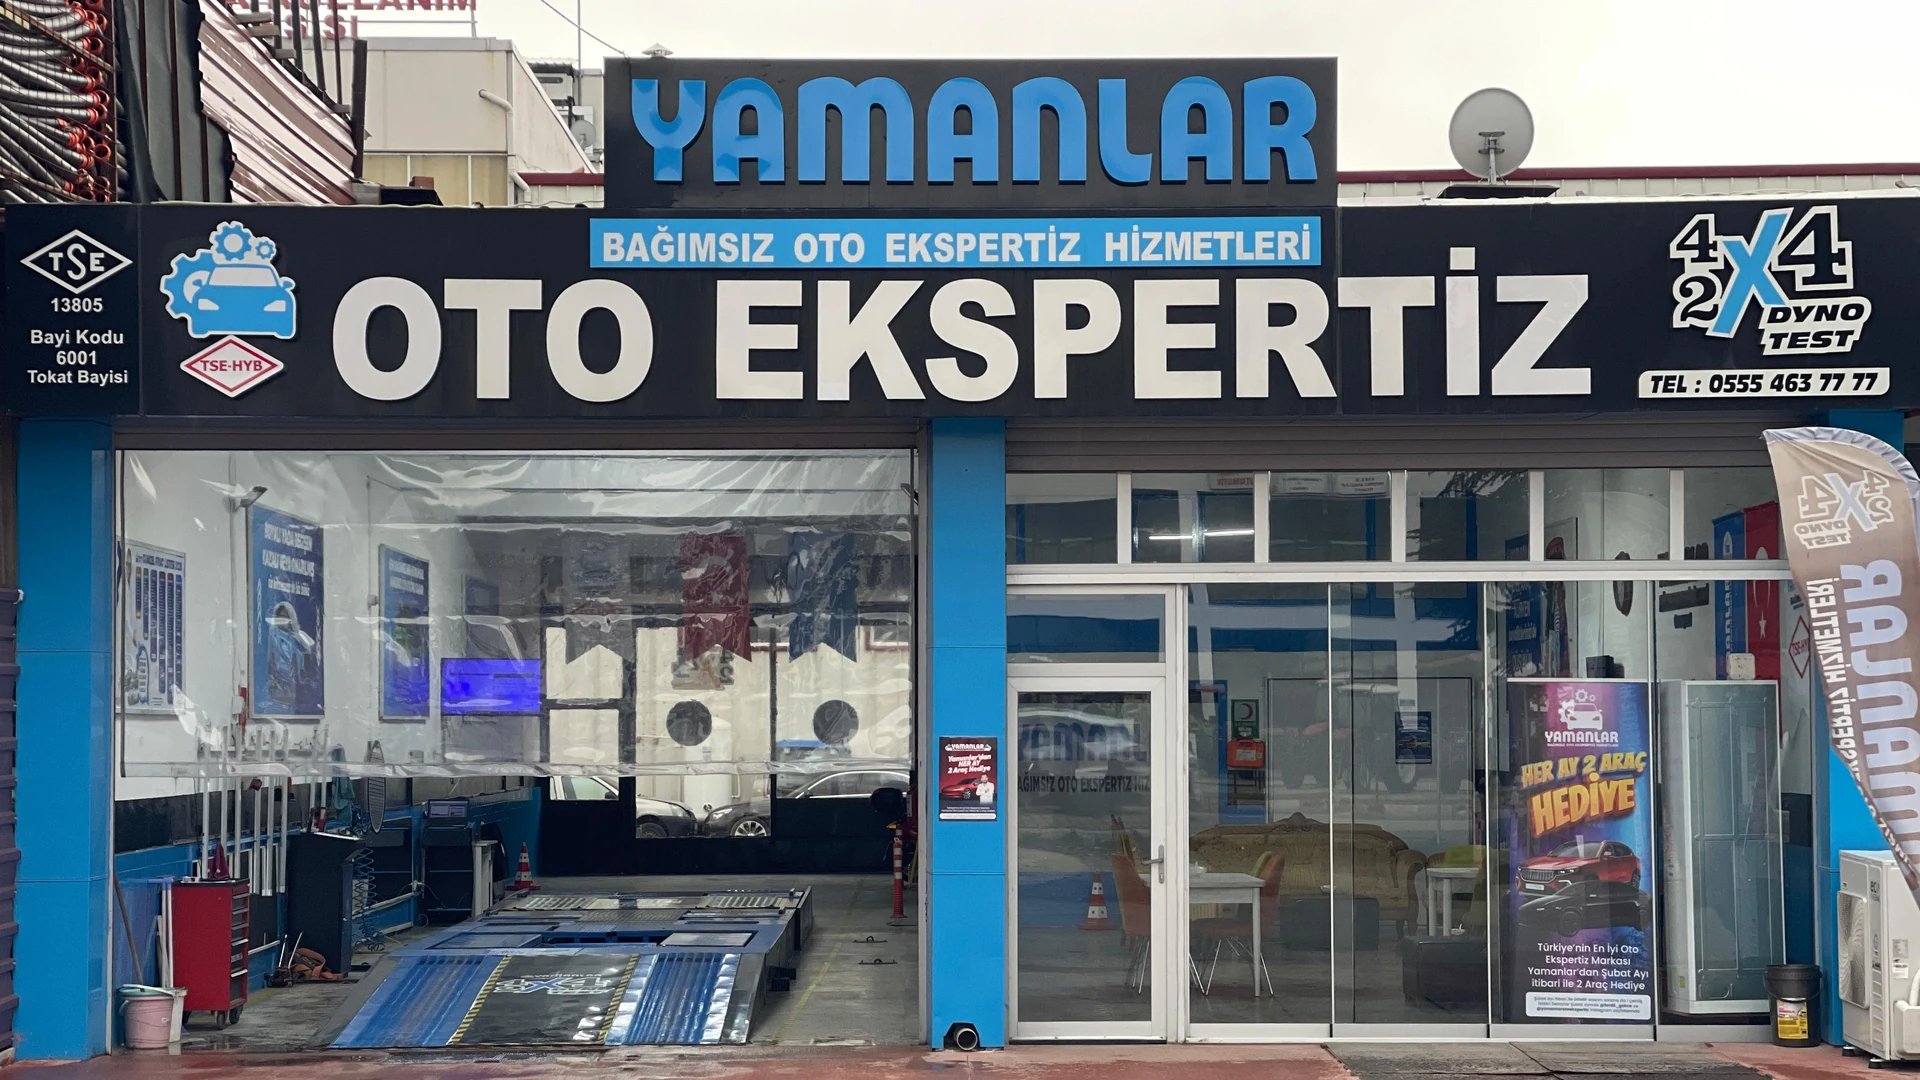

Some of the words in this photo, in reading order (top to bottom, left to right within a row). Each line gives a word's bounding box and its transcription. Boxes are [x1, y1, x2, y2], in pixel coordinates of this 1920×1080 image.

[631, 75, 1318, 185] YAMANLAR
[602, 225, 775, 264] BAĞIMSIZ
[793, 232, 865, 264] OTO
[885, 225, 1081, 264] EKSPERTİZ
[1105, 223, 1312, 263] HİZMETLERİ
[49, 243, 105, 280] TSE
[51, 298, 103, 312] 13805
[1766, 303, 1865, 324] DYNO
[333, 276, 654, 402] OTO
[716, 245, 1592, 402] EKSPERTİZ
[31, 330, 71, 347] Bayi
[77, 330, 124, 345] Kodu
[1768, 329, 1855, 350] TEST
[56, 351, 97, 365] 6001
[200, 360, 263, 372] TSE-HYB
[27, 370, 73, 384] Tokat
[78, 370, 129, 387] Bayisi
[1650, 375, 1688, 394] TEL
[1709, 374, 1764, 393] 0555
[1770, 374, 1812, 392] 463
[1820, 373, 1845, 391] 77
[1852, 373, 1879, 391] 77
[1545, 731, 1618, 743] YAMANLAR
[952, 743, 985, 751] YAMANLAR
[948, 754, 991, 762] Yamanlar'dan
[1521, 760, 1554, 788] HER
[1558, 756, 1581, 779] AY
[1582, 755, 1596, 775] 2
[1599, 751, 1647, 773] ARAÇ
[1531, 773, 1636, 836] HEDİYE
[1537, 943, 1591, 954] Türkiye'nin
[1593, 944, 1605, 953] En
[1607, 943, 1618, 955] İyi
[1621, 945, 1639, 953] Oto
[1545, 955, 1589, 966] Ekspertiz
[1591, 956, 1631, 965] Markası
[1528, 967, 1599, 976] Yamanlar'dan
[1601, 968, 1631, 979] Şubat
[1633, 969, 1649, 979] Ayı
[1563, 978, 1574, 988] ile
[1577, 979, 1584, 988] 2
[1585, 979, 1608, 991] Araç
[1610, 980, 1646, 991] Hediye
